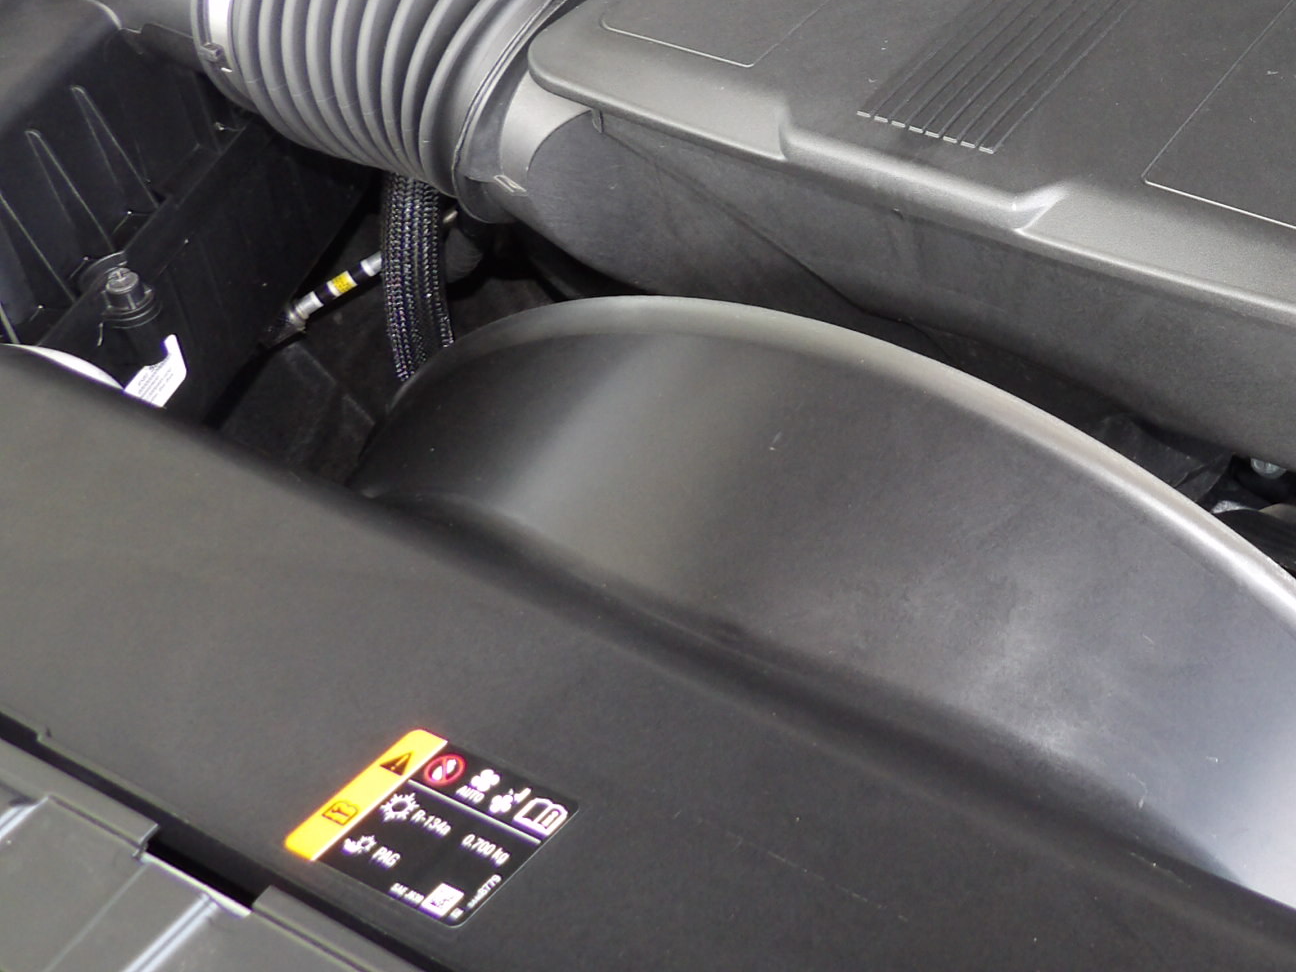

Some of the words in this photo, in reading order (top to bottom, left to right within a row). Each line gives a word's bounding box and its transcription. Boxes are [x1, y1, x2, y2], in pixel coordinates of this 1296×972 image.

[455, 786, 486, 804] AUTO
[410, 808, 452, 837] R-134a
[461, 833, 497, 858] 0.700
[492, 848, 511, 867] kg
[372, 846, 402, 869] PAG
